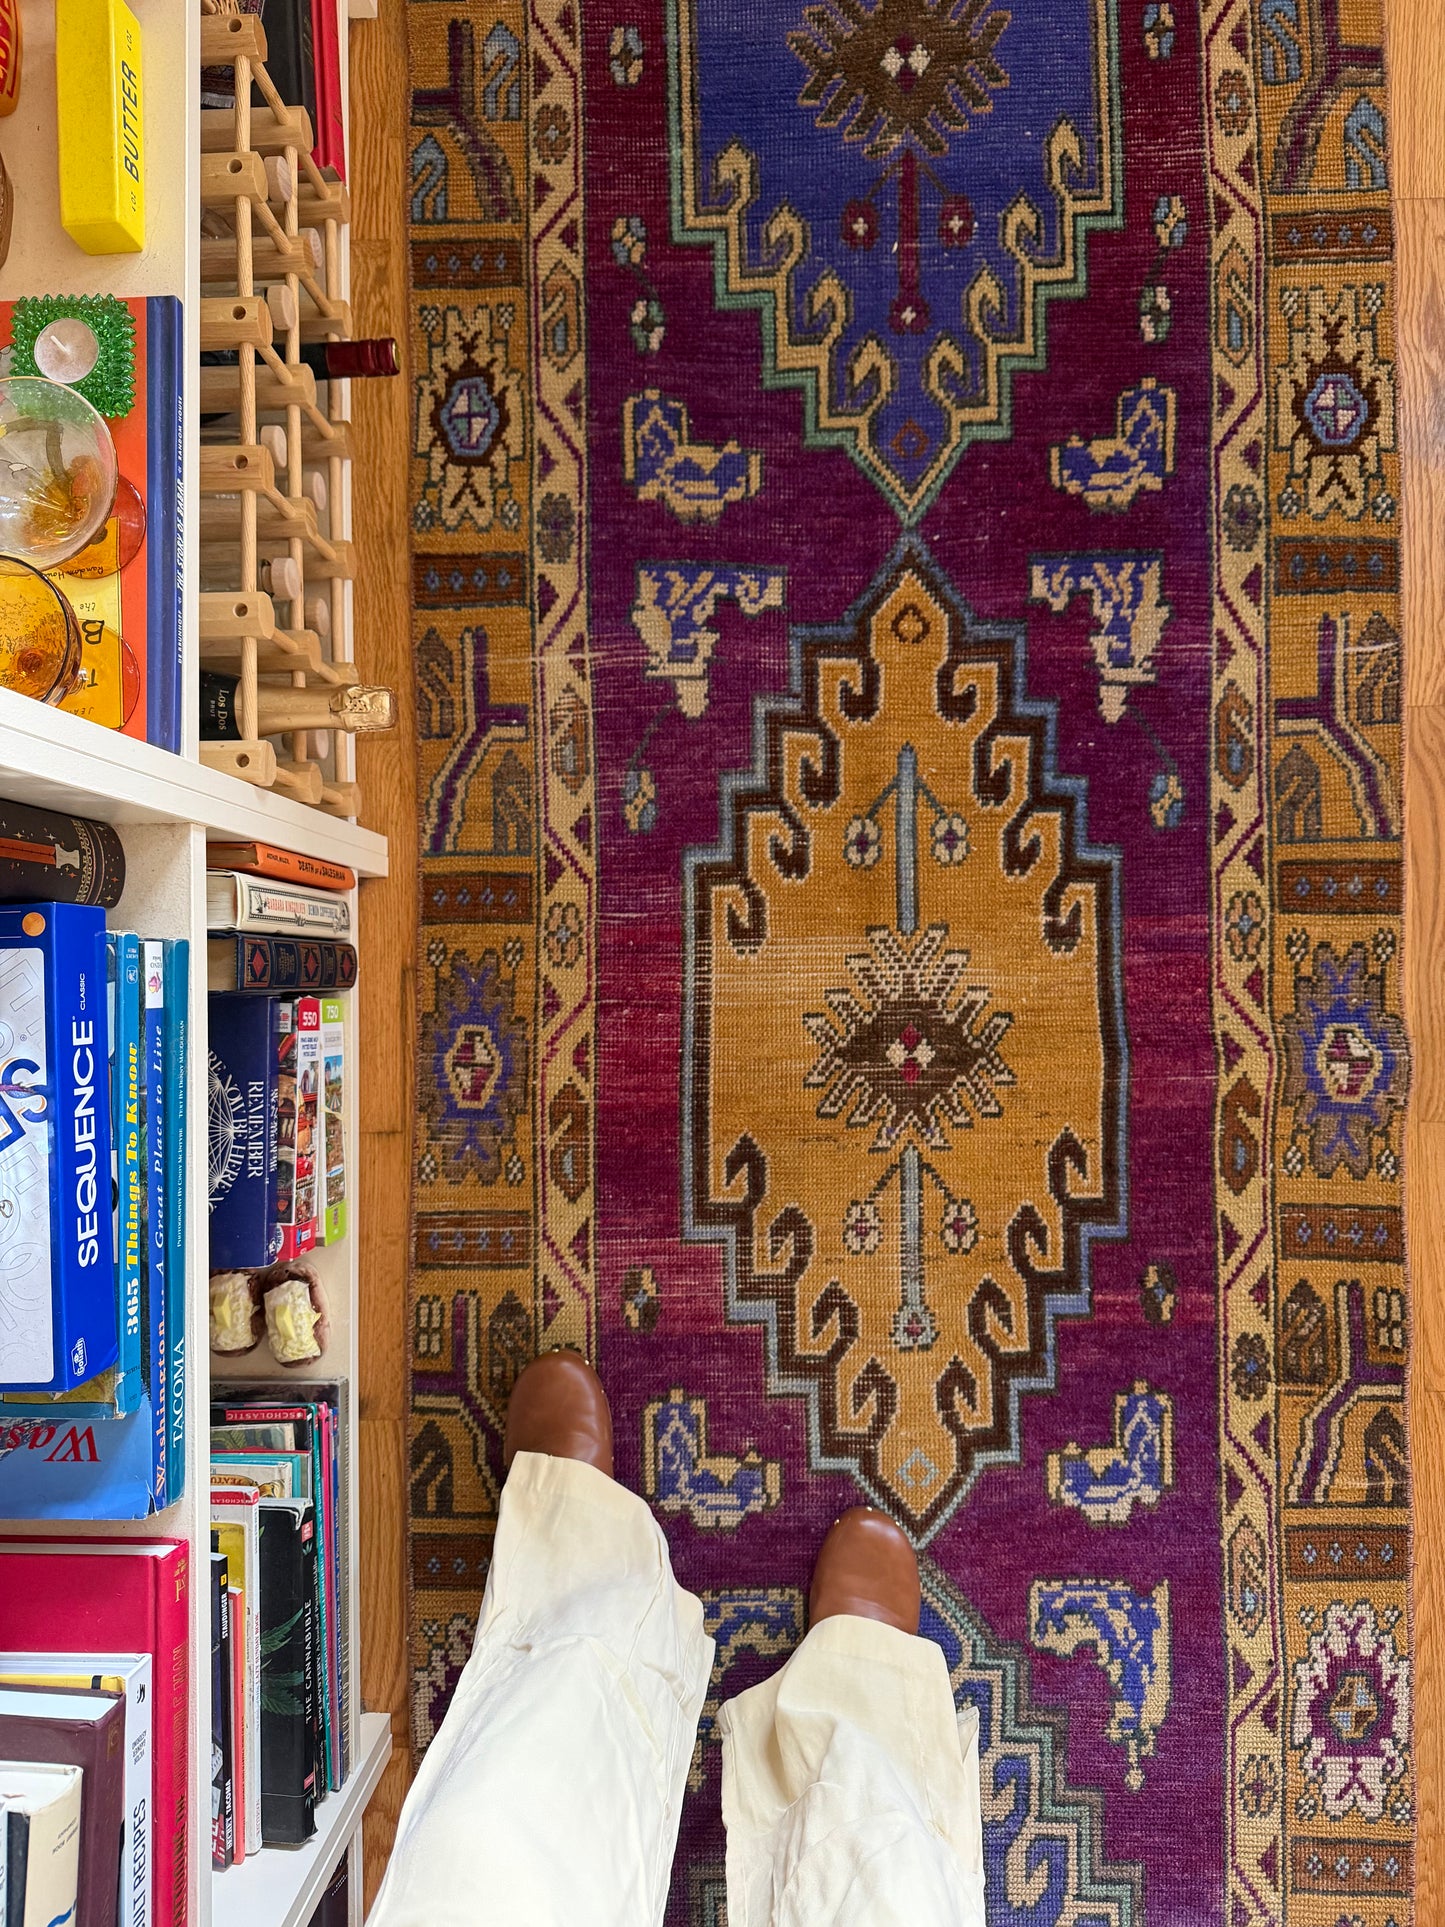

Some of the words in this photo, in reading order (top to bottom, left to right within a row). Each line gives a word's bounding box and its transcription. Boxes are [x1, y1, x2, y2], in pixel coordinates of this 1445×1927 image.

[121, 60, 140, 184] BUTTER
[176, 477, 184, 517] BABAR
[176, 519, 184, 533] OF
[176, 533, 184, 569] STORY
[176, 571, 184, 592] THE
[302, 1011, 318, 1027] 550
[326, 1005, 339, 1019] 750
[153, 1024, 164, 1073] Live
[126, 1042, 138, 1126] Know
[154, 1083, 163, 1105] to
[72, 1020, 99, 1268] SEQUENCE
[126, 1131, 138, 1165] To
[153, 1110, 164, 1176] Place
[231, 1117, 248, 1141] BE
[247, 1080, 265, 1179] REMEMBER
[126, 1171, 141, 1272] Things
[154, 1184, 164, 1249] Great
[155, 1260, 164, 1277] A
[126, 1278, 139, 1336] 365
[75, 1338, 85, 1374] Goliath
[172, 1336, 185, 1449] TACOMA
[227, 1411, 297, 1421] SCHOLASTIC
[221, 1592, 229, 1639] STAUDINGER
[304, 1599, 312, 1690] CANNABIBLE
[304, 1693, 312, 1724] THE
[341, 1681, 350, 1754] SALVADOR
[131, 1799, 146, 1889] RECIPES
